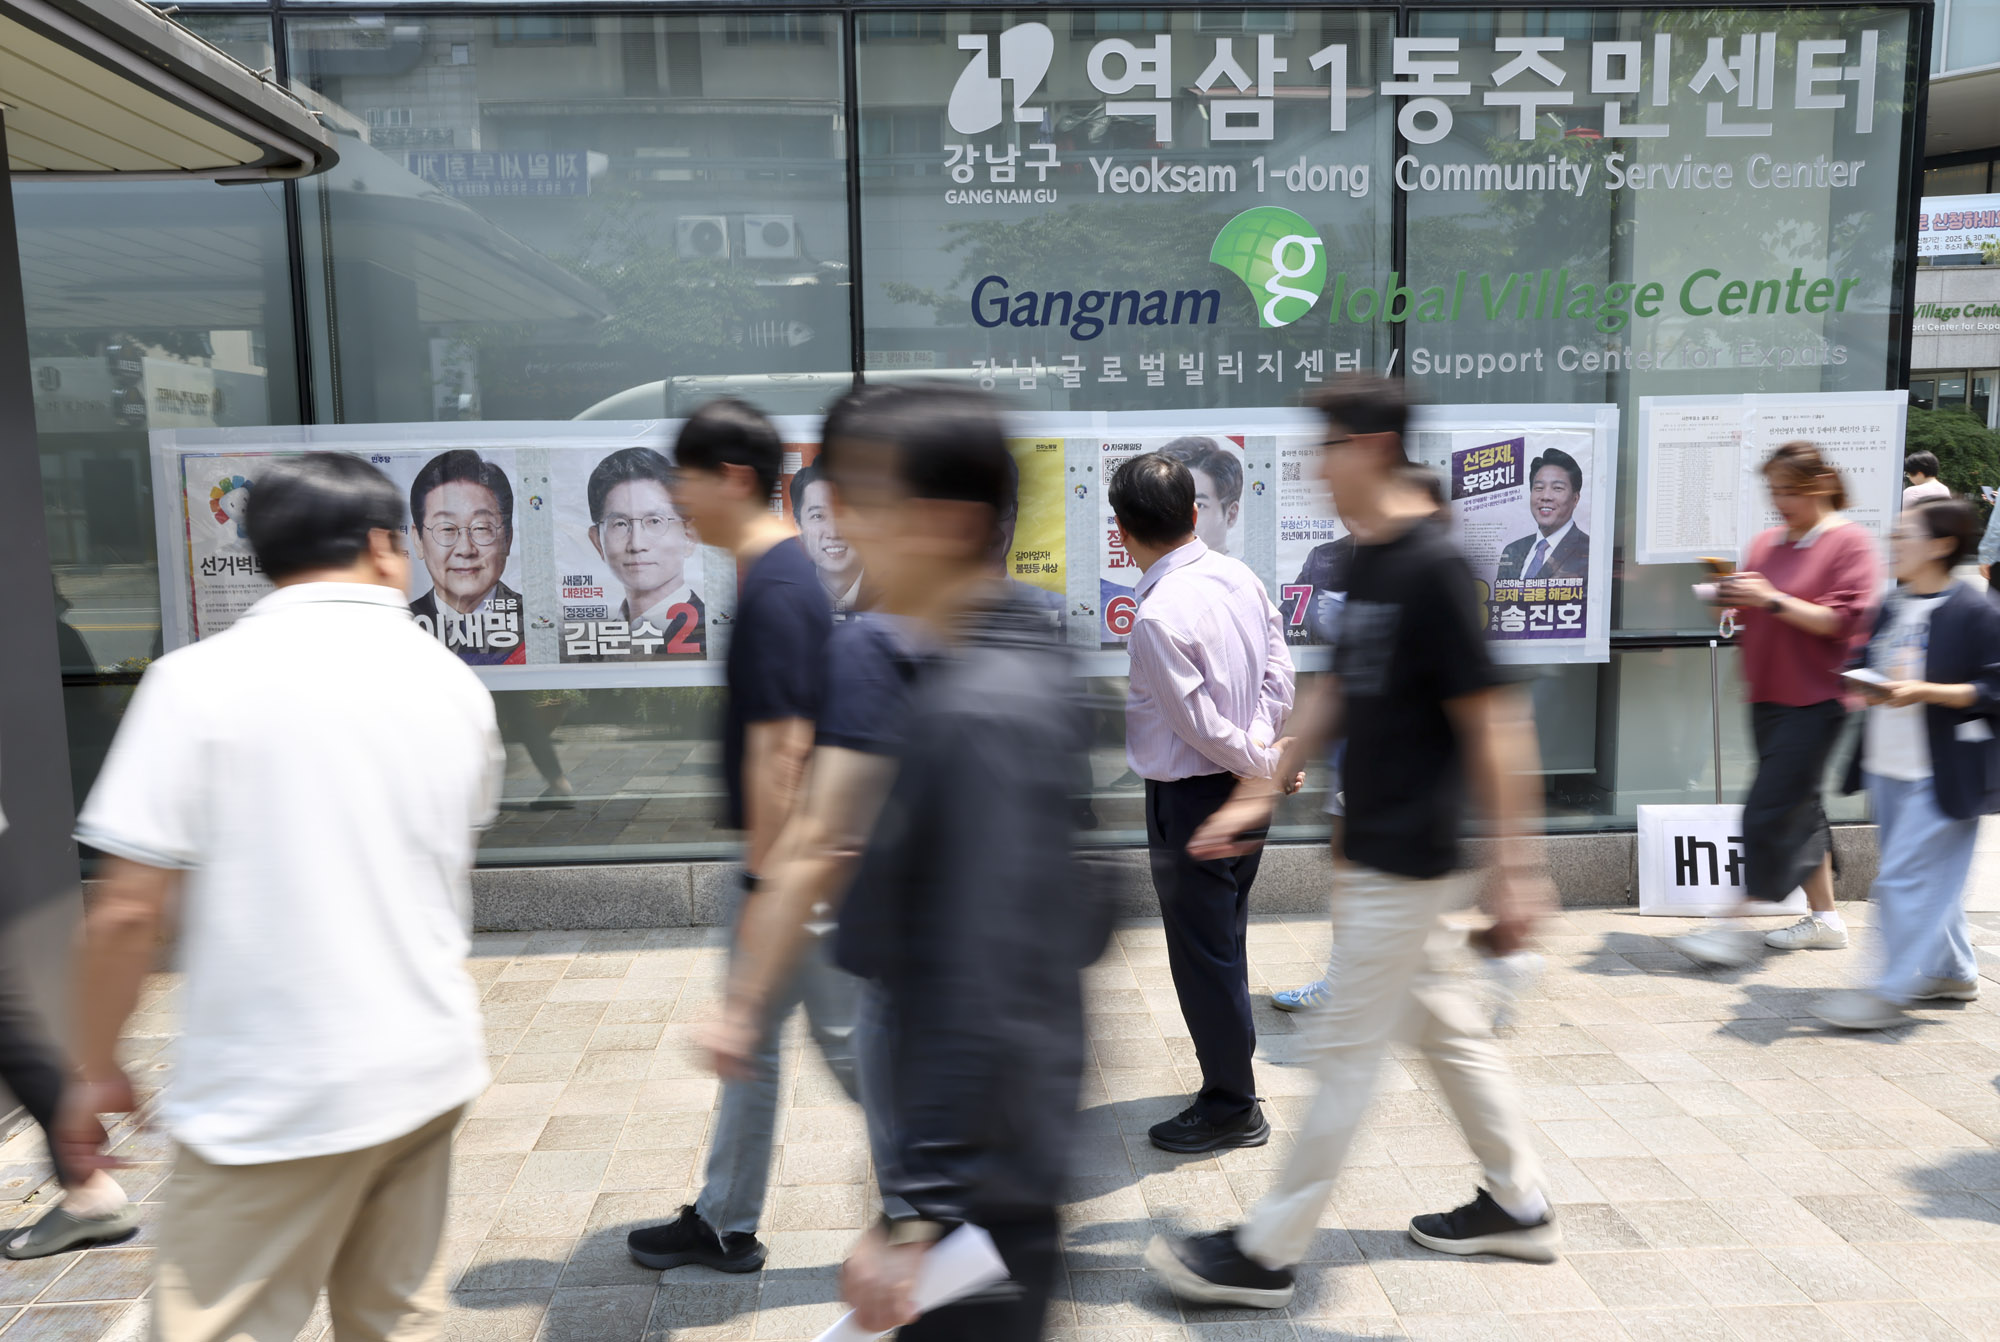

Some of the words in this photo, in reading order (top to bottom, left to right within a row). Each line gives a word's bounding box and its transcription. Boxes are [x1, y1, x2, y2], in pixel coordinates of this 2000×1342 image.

[1086, 29, 1879, 145] 역삼1동주민센터
[943, 143, 1061, 184] 강남구
[1089, 156, 1237, 194] Yeoksam
[1251, 155, 1370, 198] 1-dong
[1394, 153, 1592, 197] Community
[1604, 153, 1733, 191] Service
[1746, 152, 1866, 190] Center
[945, 188, 993, 204] GANG
[994, 188, 1031, 204] NAM
[1034, 188, 1057, 204] GU
[1932, 210, 2000, 231] 신청하세
[971, 275, 1221, 341] Gangnam
[1478, 267, 1664, 334] Village
[1678, 267, 1861, 316] Center
[1411, 347, 1544, 379] Support
[1557, 345, 1667, 373] Center
[1681, 343, 1722, 368] for
[1736, 341, 1849, 371] Expats
[1110, 443, 1142, 451] 자유통일당
[1463, 444, 1514, 472] 선경제,
[1463, 464, 1515, 493] 후정치!
[1281, 520, 1311, 530] 부정선거
[1312, 519, 1335, 529] 척결로
[1281, 531, 1311, 541] 청년에게
[1312, 530, 1335, 540] 미래를
[1015, 551, 1051, 561] 갈아엎자!
[1015, 564, 1040, 574] 불평등
[1041, 563, 1058, 573] 세상
[562, 575, 593, 586] 새롭게
[562, 587, 604, 599] 대한민국
[1548, 587, 1583, 601] 해결사
[484, 599, 518, 611] 지금은
[566, 607, 606, 619] 정정당당
[1282, 584, 1313, 626] 7
[1500, 602, 1583, 633] 송진호
[414, 612, 520, 648] 이재명
[564, 621, 665, 655] 김문수
[666, 602, 700, 654] 2
[1286, 629, 1308, 638] 무소속
